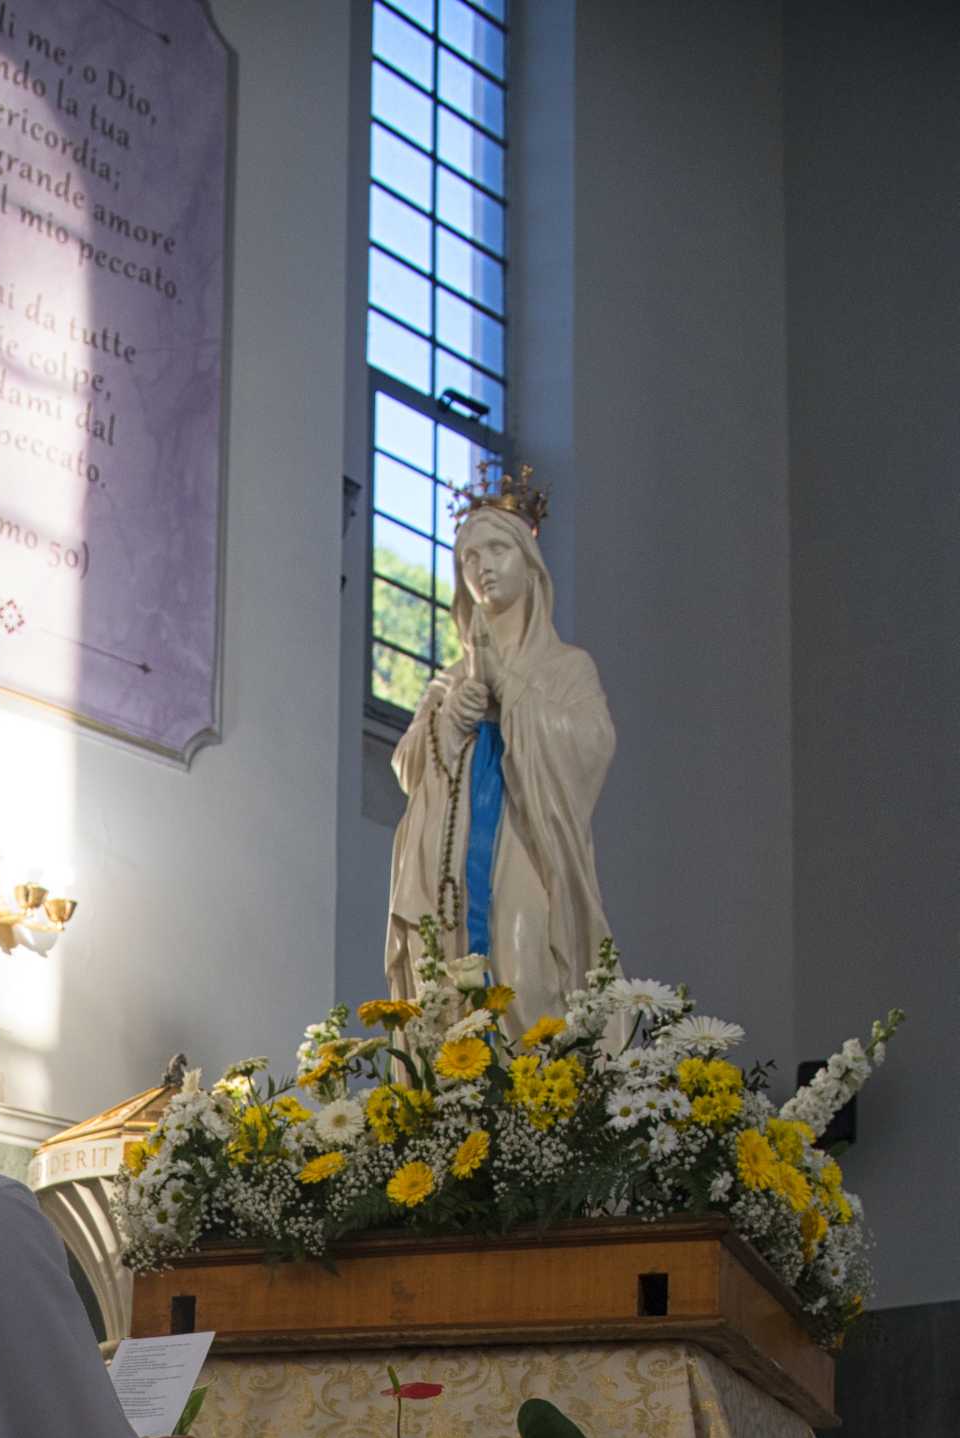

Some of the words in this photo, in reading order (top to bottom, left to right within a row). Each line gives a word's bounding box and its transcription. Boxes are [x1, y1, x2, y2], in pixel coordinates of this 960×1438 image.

[27, 29, 74, 76] me,
[82, 66, 97, 85] o
[107, 69, 158, 127] Dio,
[57, 79, 79, 118] la
[89, 109, 132, 151] tua
[19, 204, 70, 246] mio
[77, 237, 185, 306] peccato.
[93, 203, 178, 257] amore
[24, 292, 57, 334] da
[68, 316, 138, 365] tutte
[28, 351, 114, 401] colpe,
[75, 402, 117, 448] dal
[47, 540, 91, 581] 50)
